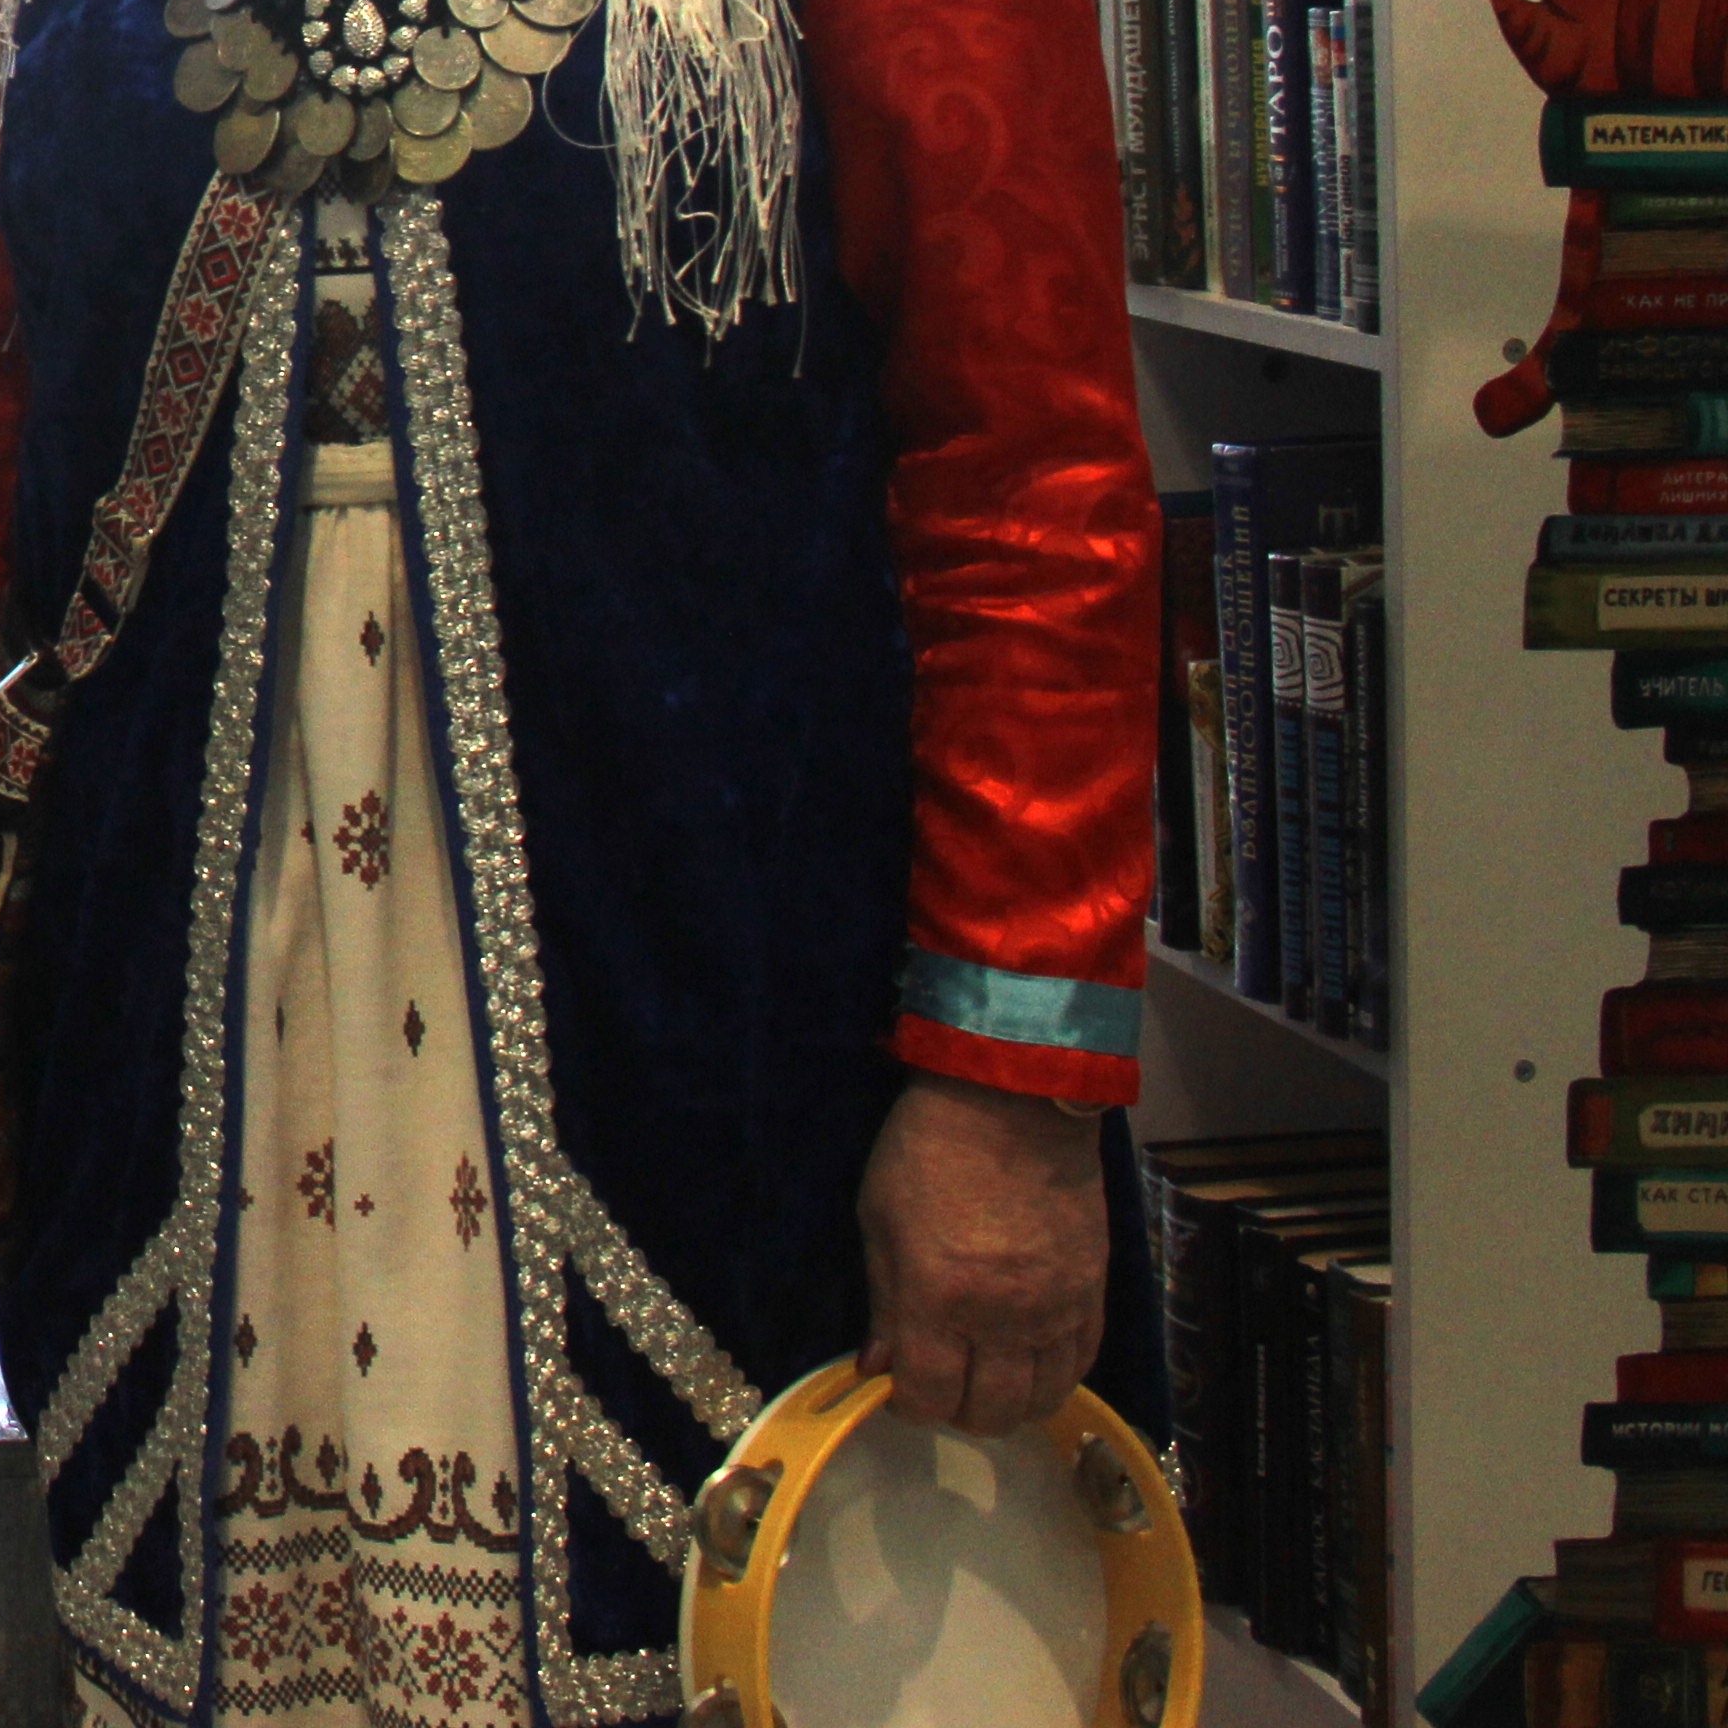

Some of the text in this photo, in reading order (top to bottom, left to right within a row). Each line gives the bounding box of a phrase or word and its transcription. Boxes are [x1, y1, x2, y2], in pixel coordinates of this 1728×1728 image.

[1265, 23, 1287, 144] ТАРО
[1592, 124, 1728, 146] МАТЕМАТИК
[1673, 293, 1697, 309] НЕ
[1604, 587, 1697, 607] СЕКРЕТЫ
[1640, 1187, 1678, 1204] КАК
